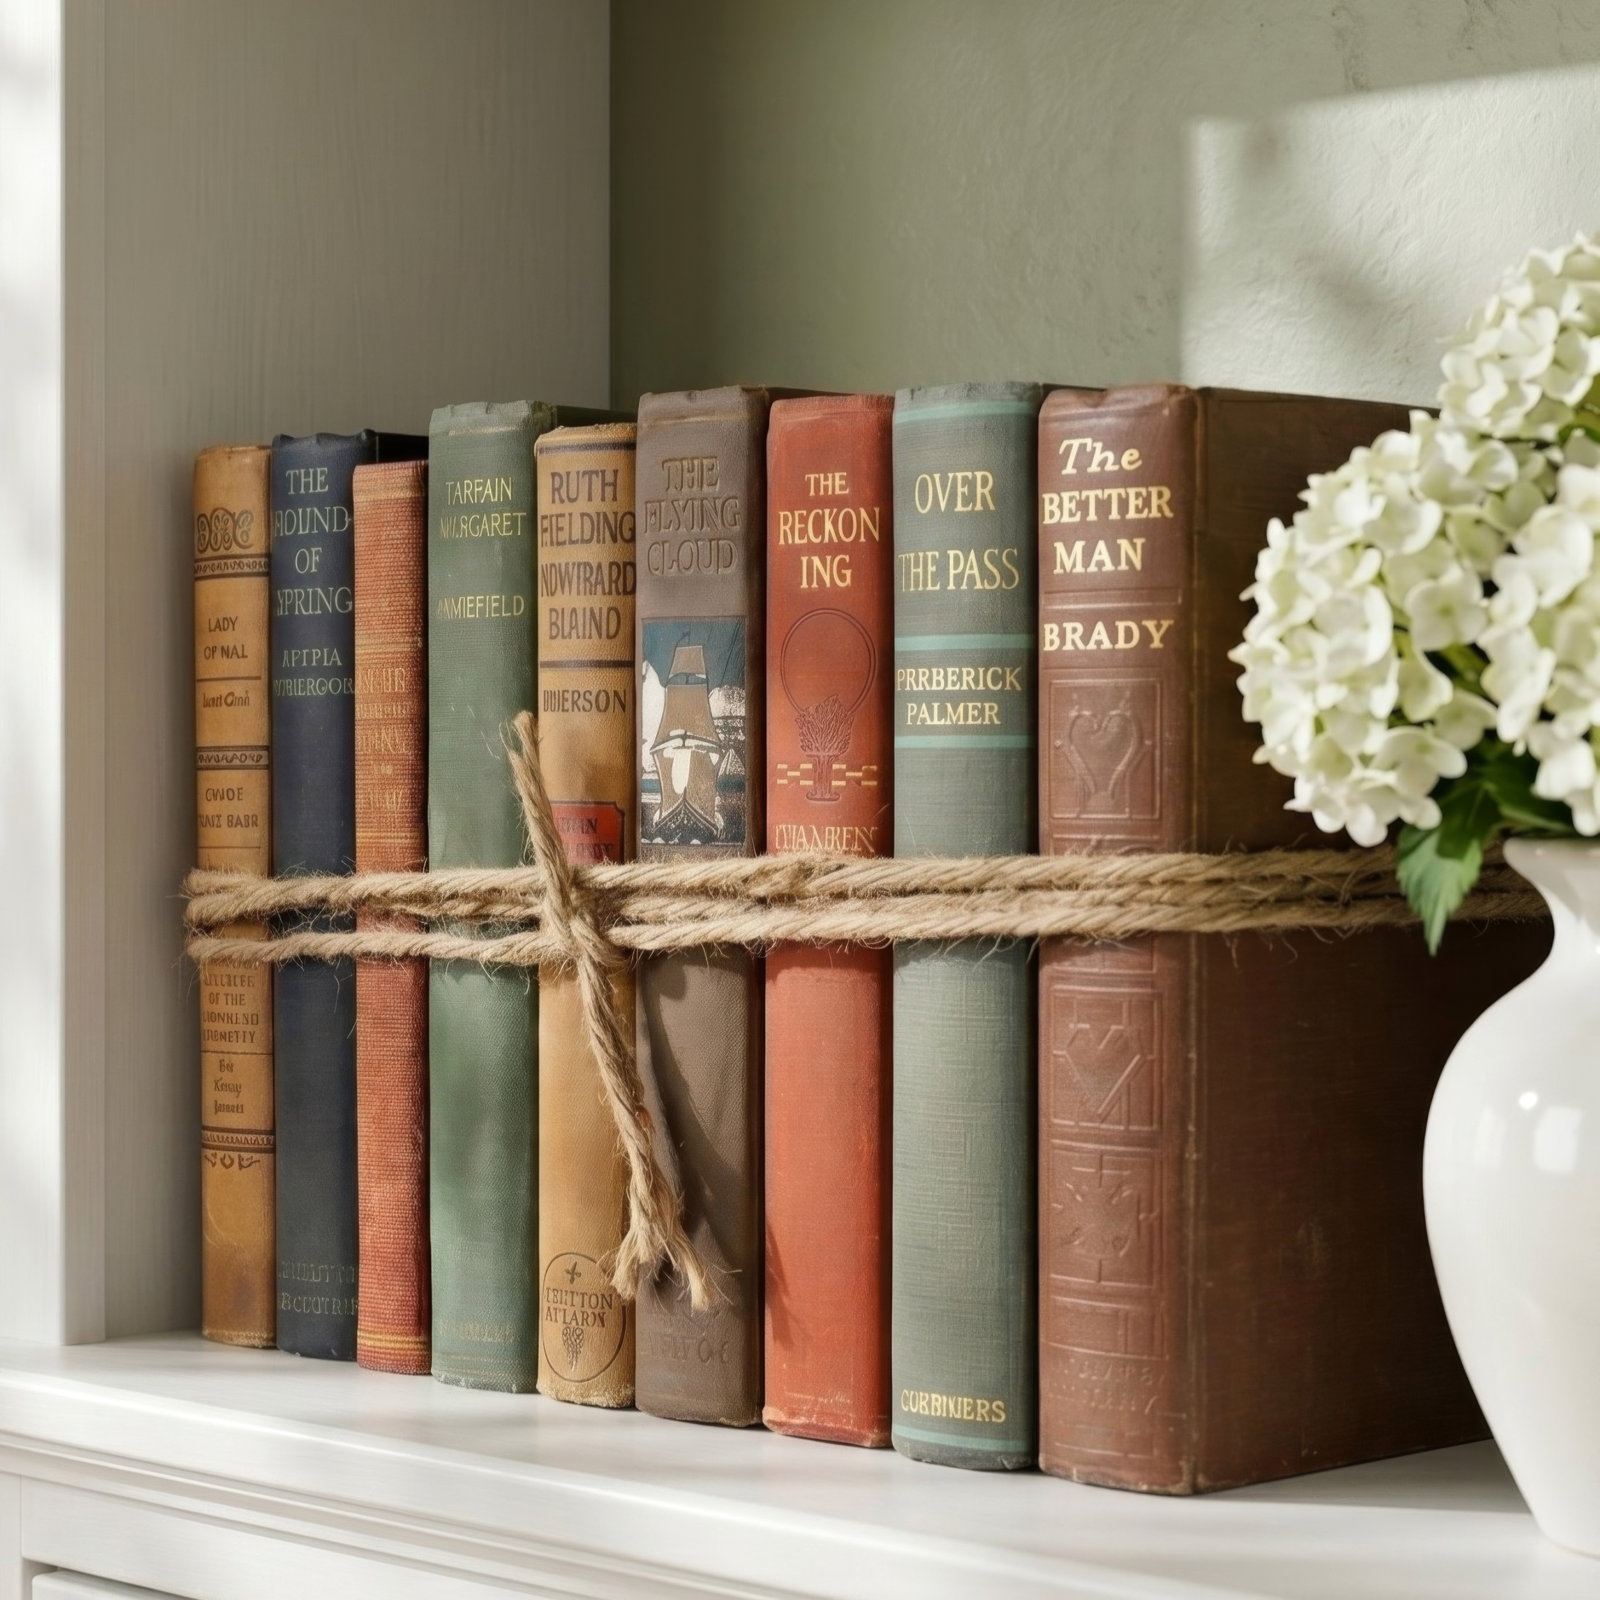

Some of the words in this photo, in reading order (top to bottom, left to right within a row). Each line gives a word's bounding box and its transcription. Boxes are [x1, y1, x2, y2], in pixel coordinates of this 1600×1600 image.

[1059, 437, 1143, 475] The
[286, 467, 329, 495] THE
[551, 469, 619, 504] RUTH
[662, 456, 720, 492] THE
[805, 472, 850, 496] THE
[914, 471, 996, 514] OVER
[1042, 486, 1174, 524] BETTER
[541, 512, 636, 547] FIELDING
[643, 496, 741, 534] FLYING
[778, 507, 880, 545] RECKON
[295, 547, 322, 574] OF
[648, 538, 737, 575] CLOUD
[800, 554, 852, 588] ING
[898, 551, 941, 592] THE
[947, 548, 1020, 591] PASS
[1053, 538, 1147, 574] MAN
[208, 616, 238, 632] LADY
[1043, 620, 1174, 651] BRADY
[906, 702, 1001, 725] PALMER
